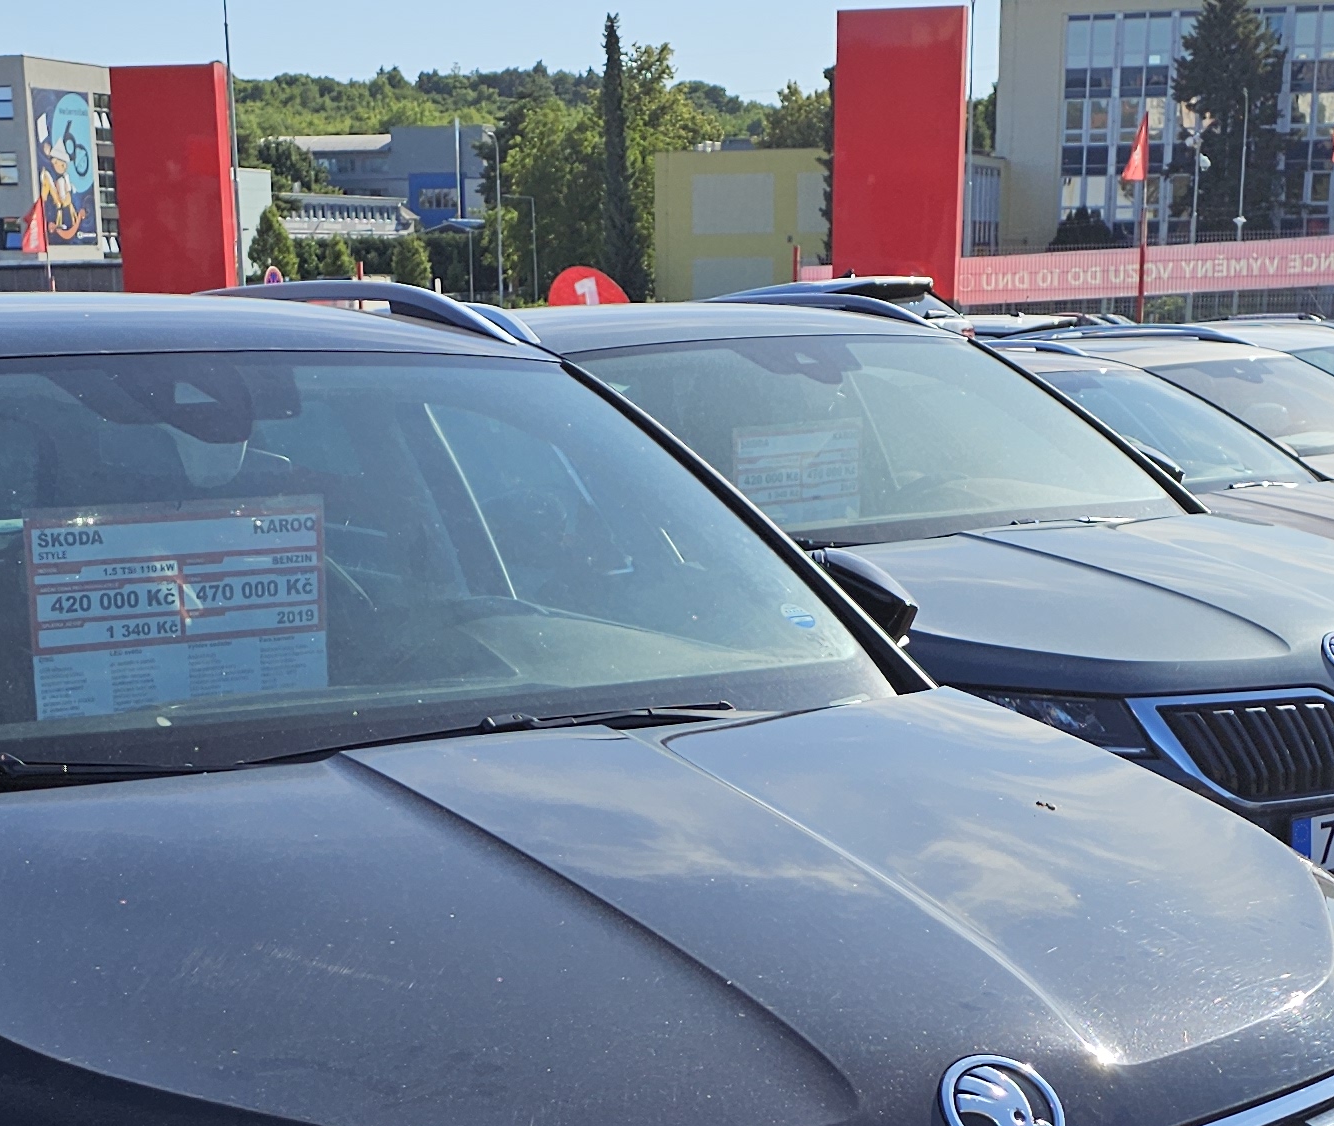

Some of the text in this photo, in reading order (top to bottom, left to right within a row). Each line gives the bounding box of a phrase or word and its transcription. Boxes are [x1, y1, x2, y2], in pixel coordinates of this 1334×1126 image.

[253, 516, 316, 535] KAROQ
[37, 528, 104, 548] ŠKODA
[38, 550, 67, 560] STYLE
[271, 554, 313, 565] BENZIN
[103, 567, 119, 577] 1.5
[159, 562, 176, 573] kW
[196, 578, 314, 603] 470 000 Kč
[50, 587, 177, 614] 420 000 Kč
[277, 609, 315, 625] 2019
[106, 619, 179, 638] 1 340 Kč
